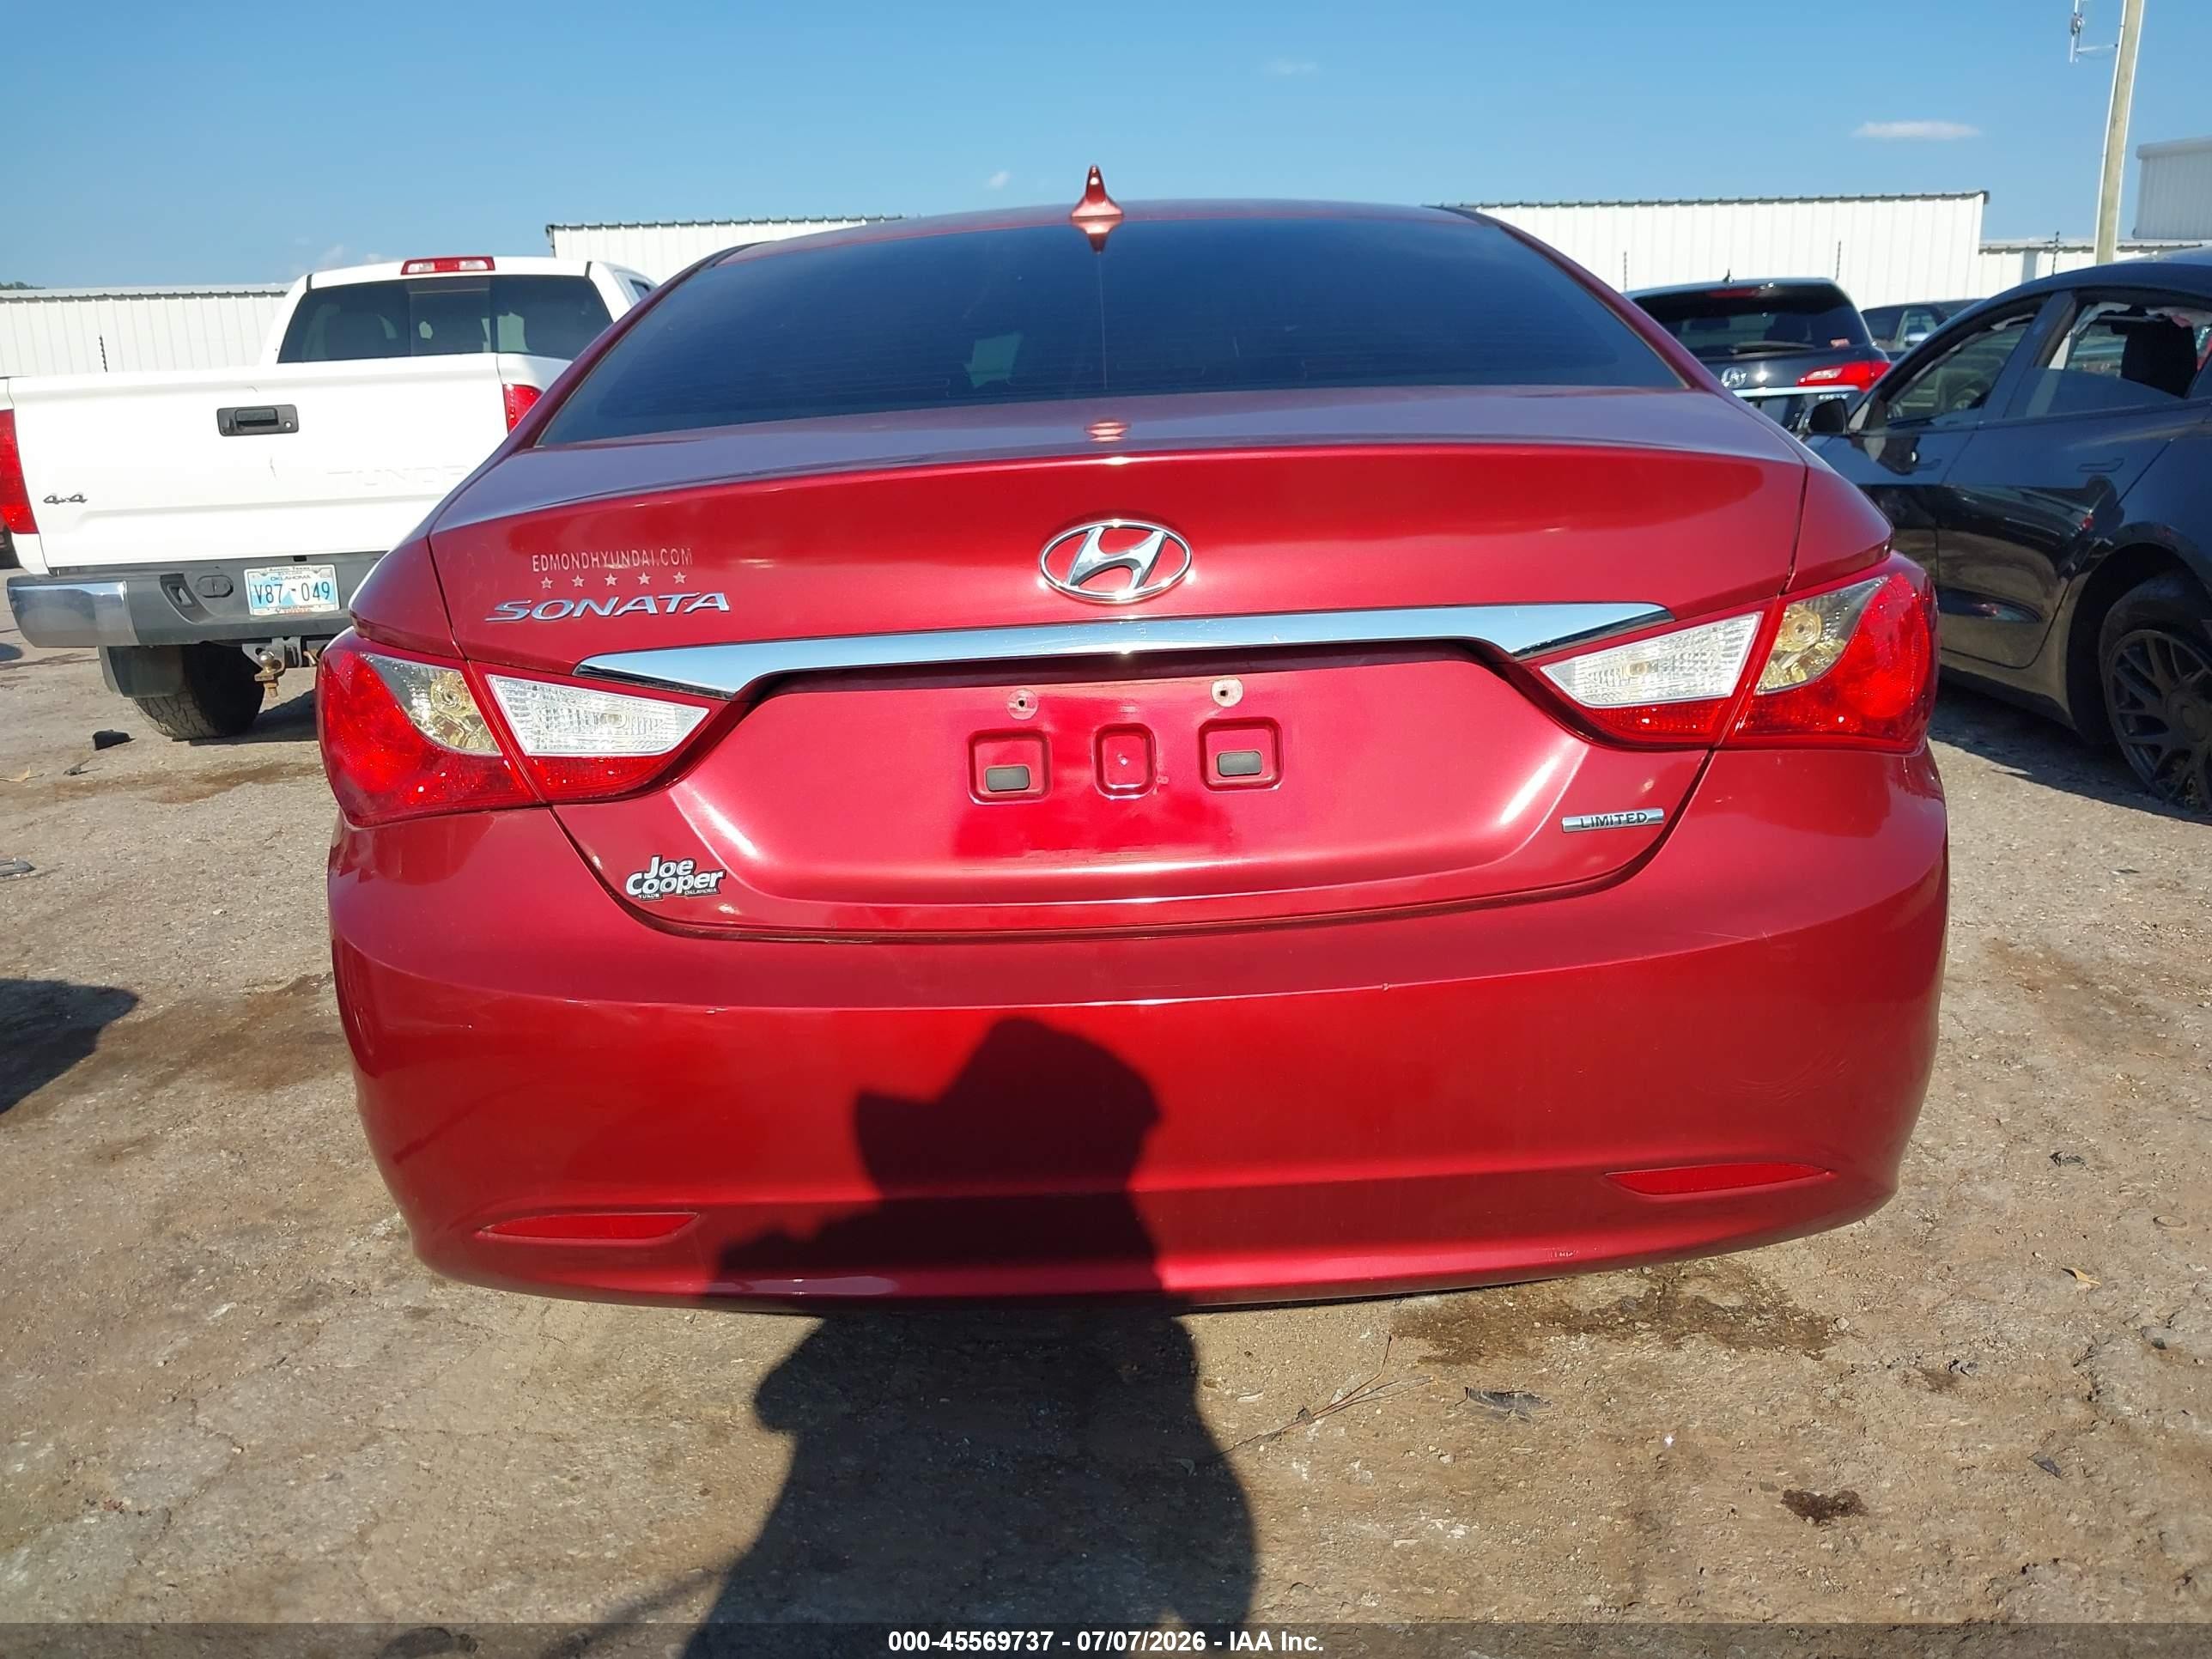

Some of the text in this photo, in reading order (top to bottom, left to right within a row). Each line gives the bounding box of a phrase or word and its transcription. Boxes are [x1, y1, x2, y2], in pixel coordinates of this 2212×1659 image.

[532, 547, 693, 573] EDMONDHYUNDAI.COM
[484, 592, 731, 622] SONATA
[1580, 812, 1649, 829] LIMITED
[643, 855, 695, 879] Joe
[625, 870, 724, 895] Cooper
